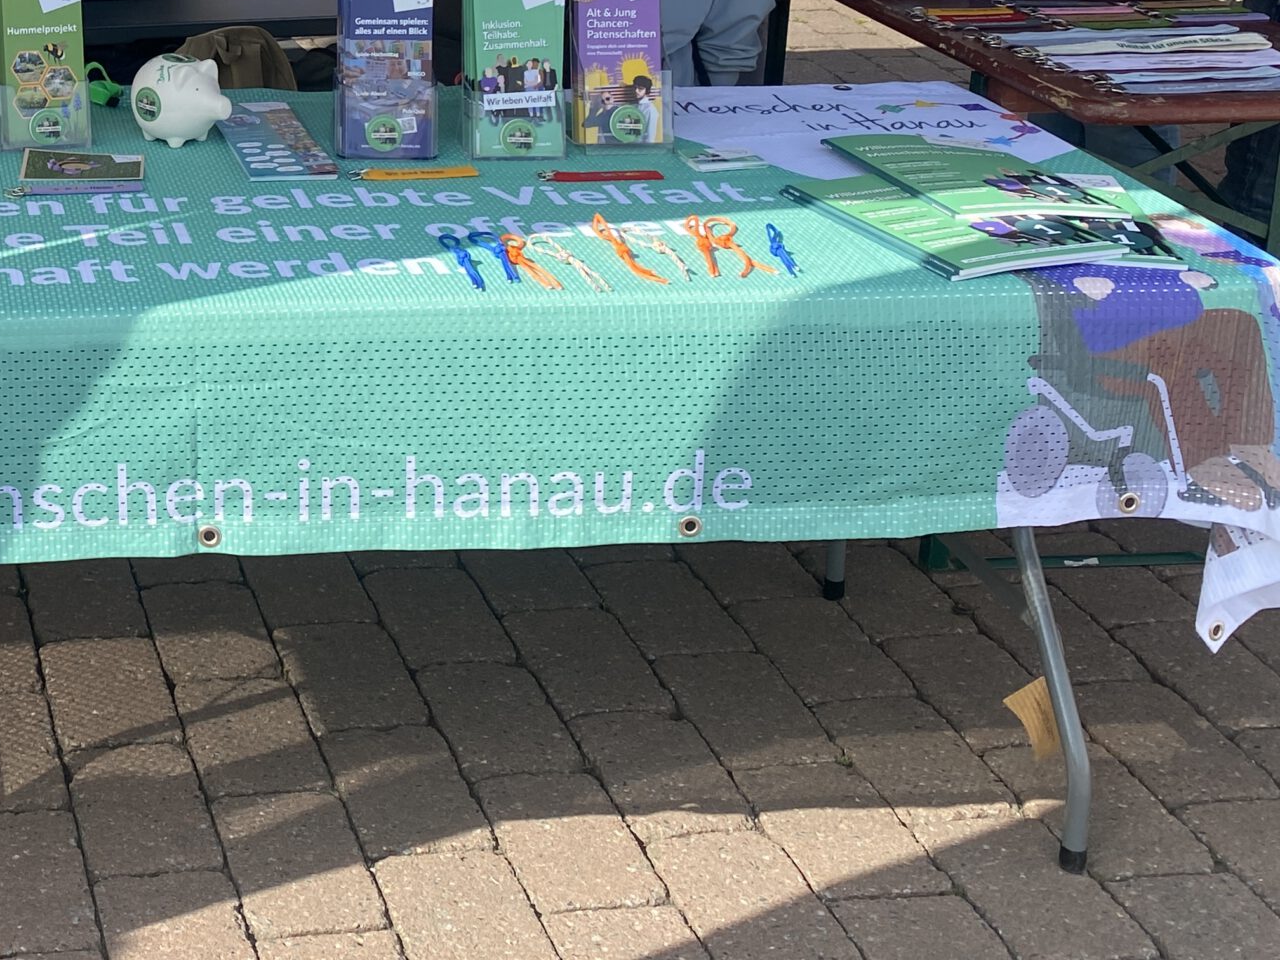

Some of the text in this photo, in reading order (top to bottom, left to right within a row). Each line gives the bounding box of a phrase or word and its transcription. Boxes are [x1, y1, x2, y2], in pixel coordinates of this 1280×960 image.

[586, 8, 637, 19] Alt & Jung
[355, 17, 429, 26] Gemeinsam spielen:
[482, 20, 523, 30] Inklusion.
[586, 19, 633, 28] Chancen-
[7, 24, 78, 36] Hummelprojekt
[355, 27, 428, 35] alles auf einen Blick
[483, 31, 520, 40] Teilhabe.
[586, 29, 656, 39] Patenschaften
[483, 39, 549, 51] Zusammenhalt.
[486, 94, 553, 106] Wir leben Vielfalt
[673, 93, 857, 116] Menschen
[802, 112, 987, 132] in Hanau
[86, 192, 189, 215] für
[210, 187, 474, 216] gelebte
[482, 180, 775, 207] Vielfalt.
[63, 222, 193, 247] Teil
[216, 219, 401, 244] einer
